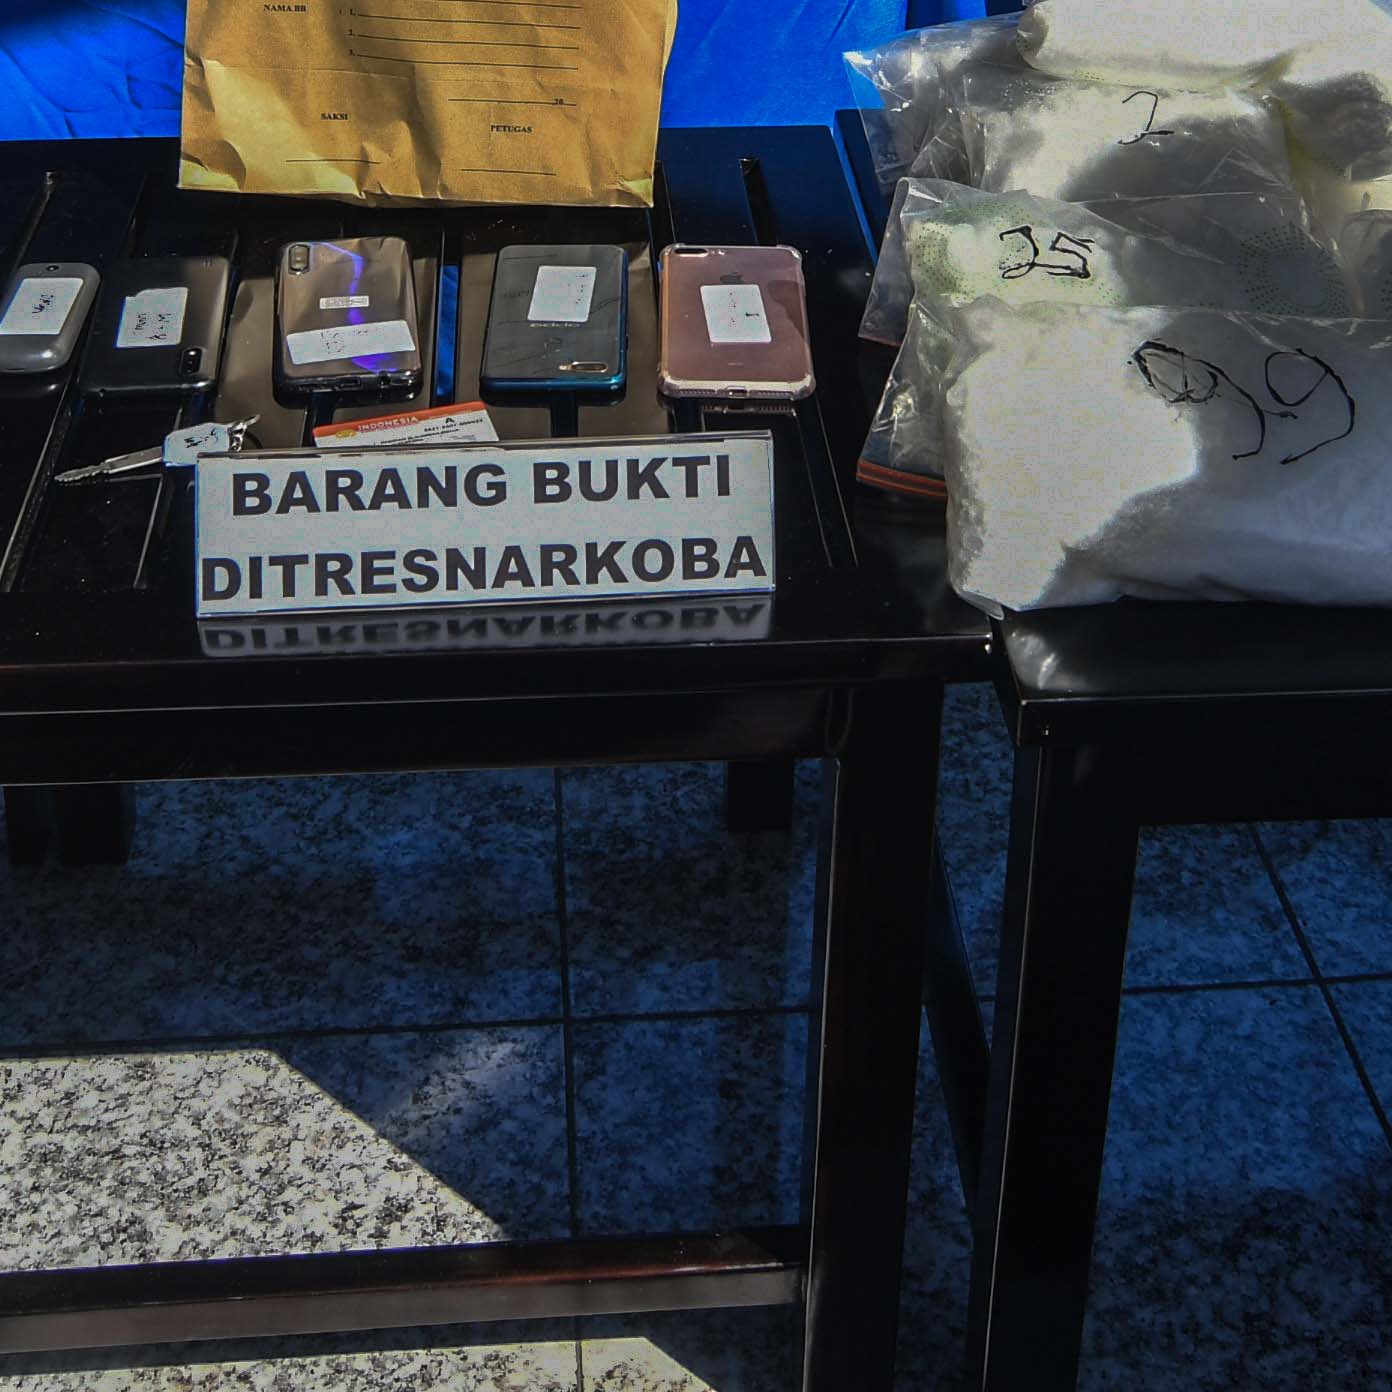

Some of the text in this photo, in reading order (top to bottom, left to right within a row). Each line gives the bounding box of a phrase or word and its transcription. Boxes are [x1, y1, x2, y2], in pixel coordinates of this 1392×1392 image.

[320, 112, 349, 121] SAKSI
[489, 124, 533, 134] PETUGAS
[358, 415, 420, 431] INDONESIA
[230, 455, 731, 517] BARANG BUKTI
[201, 534, 768, 602] DITRESNARKOBA
